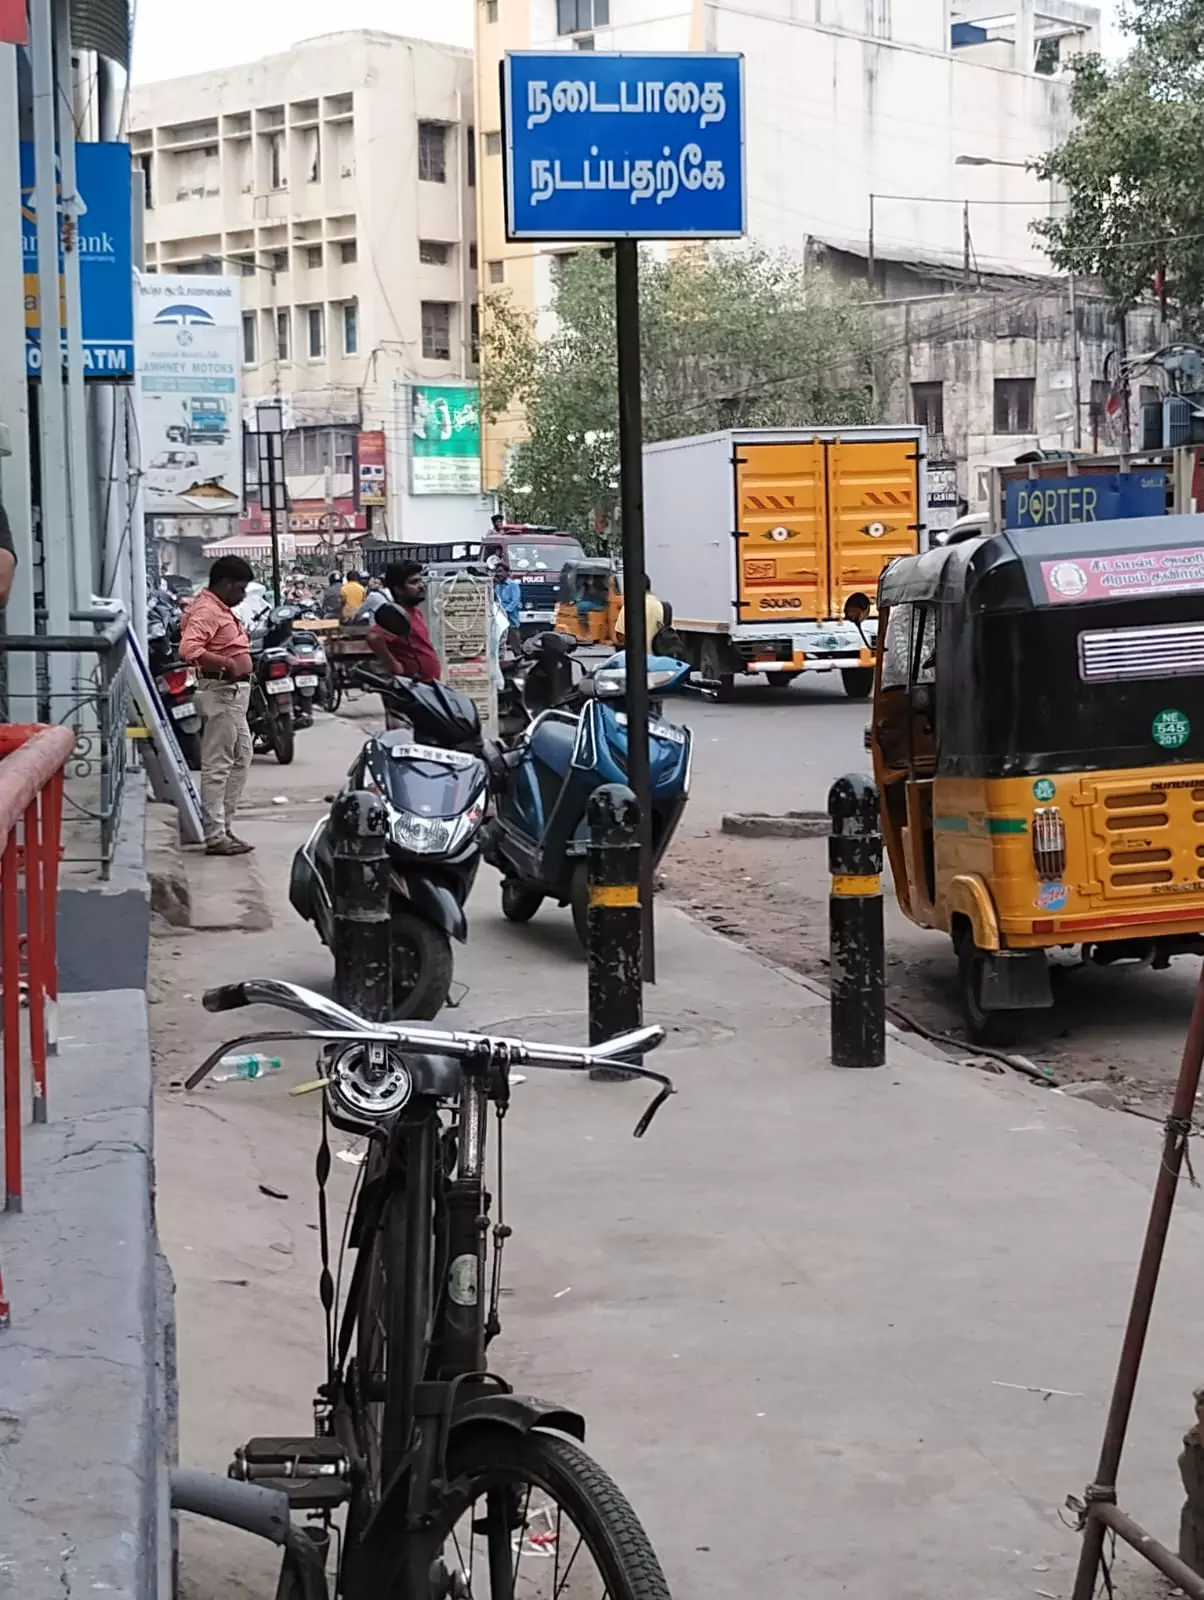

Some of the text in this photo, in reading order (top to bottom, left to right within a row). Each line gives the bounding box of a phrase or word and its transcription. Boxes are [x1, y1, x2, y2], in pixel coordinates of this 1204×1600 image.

[527, 81, 726, 129] நடைபாதை
[530, 142, 726, 206] நடப்பதற்கே
[74, 232, 114, 253] ank
[83, 349, 126, 369] ATM
[1017, 487, 1097, 525] PORTER
[522, 575, 545, 583] POLICE
[759, 597, 802, 610] SOUND
[1162, 712, 1178, 723] NE
[1157, 722, 1185, 733] 545
[1159, 734, 1184, 745] 2017
